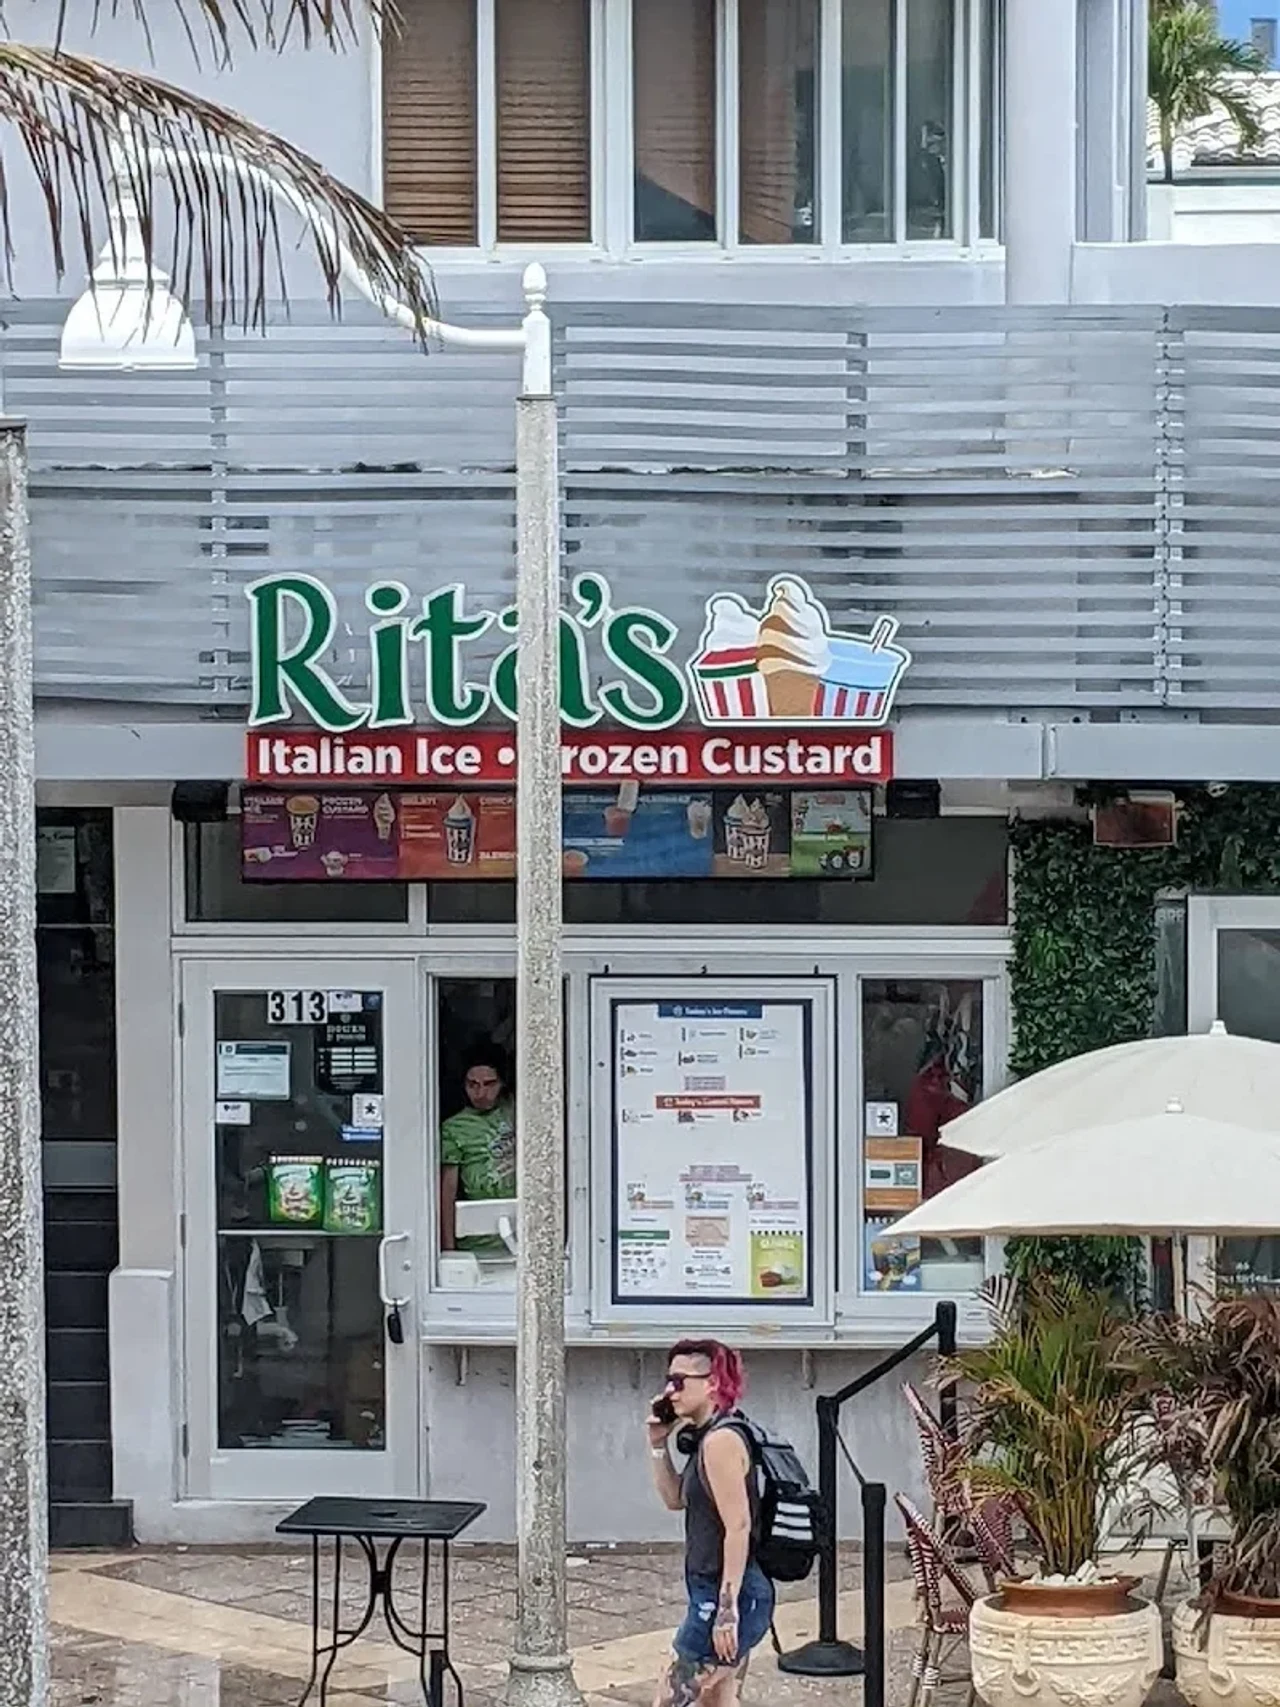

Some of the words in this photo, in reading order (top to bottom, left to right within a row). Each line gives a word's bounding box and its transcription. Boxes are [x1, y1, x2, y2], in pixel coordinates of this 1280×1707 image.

[247, 575, 687, 730] Rita's
[258, 737, 402, 774] Italian
[417, 738, 481, 774] Ice
[560, 742, 688, 774] rozen
[701, 737, 882, 774] Custard
[271, 991, 325, 1022] 313
